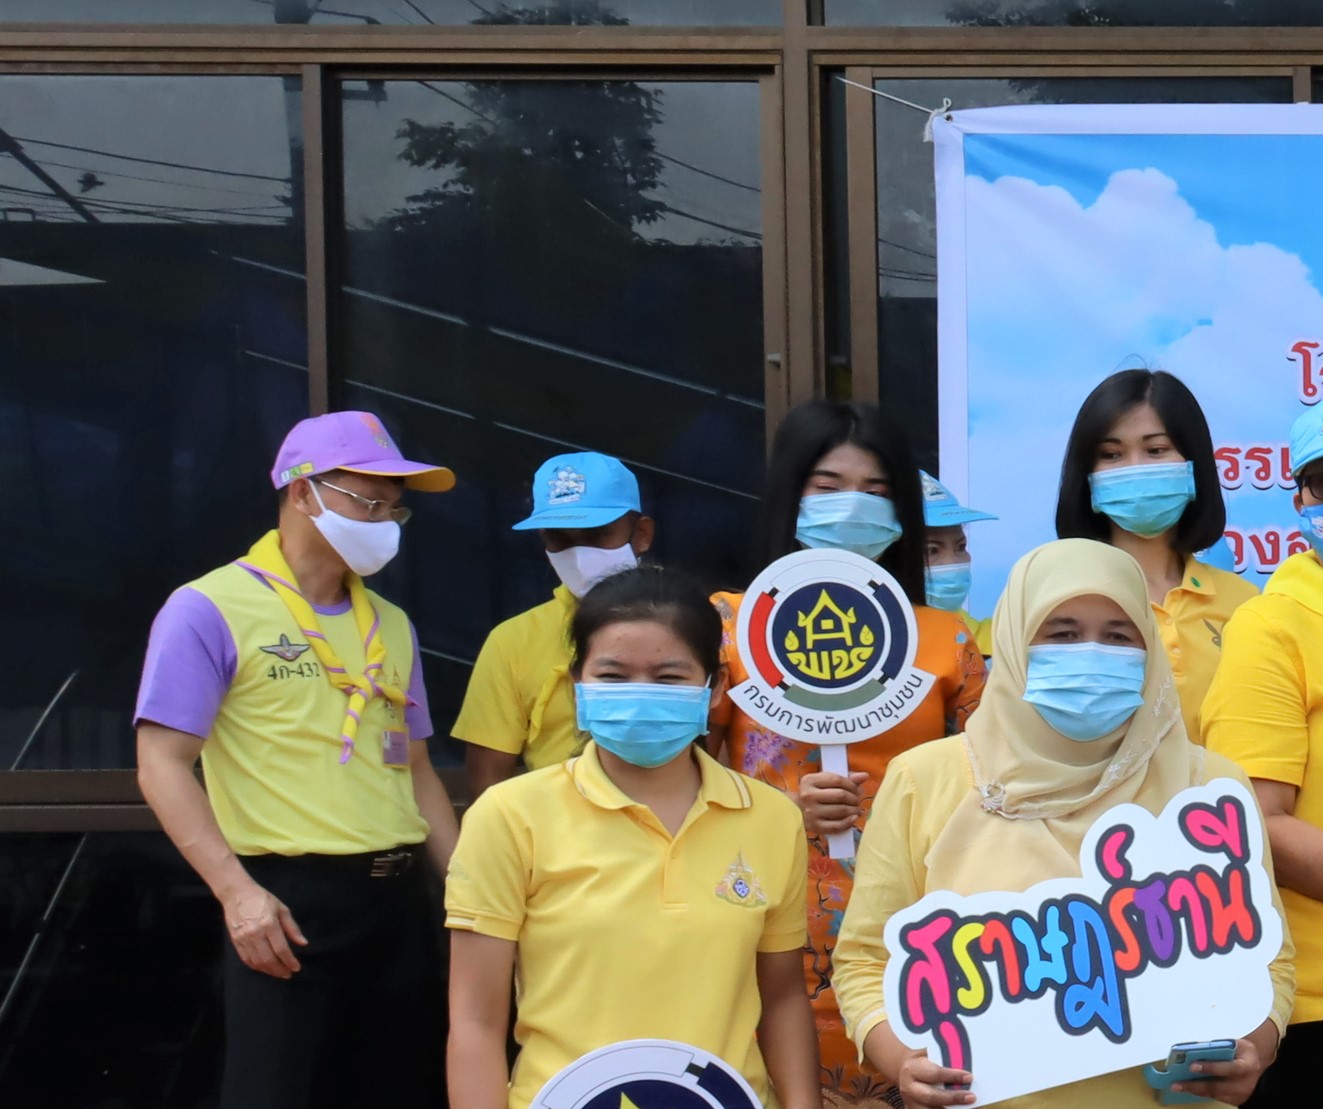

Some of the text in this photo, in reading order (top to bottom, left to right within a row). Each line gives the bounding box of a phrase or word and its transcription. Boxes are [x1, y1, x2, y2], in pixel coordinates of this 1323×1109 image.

[743, 673, 924, 735] กรมการพัฒนาชุมชน
[900, 796, 1261, 1091] สุราษฎร์ธานี
